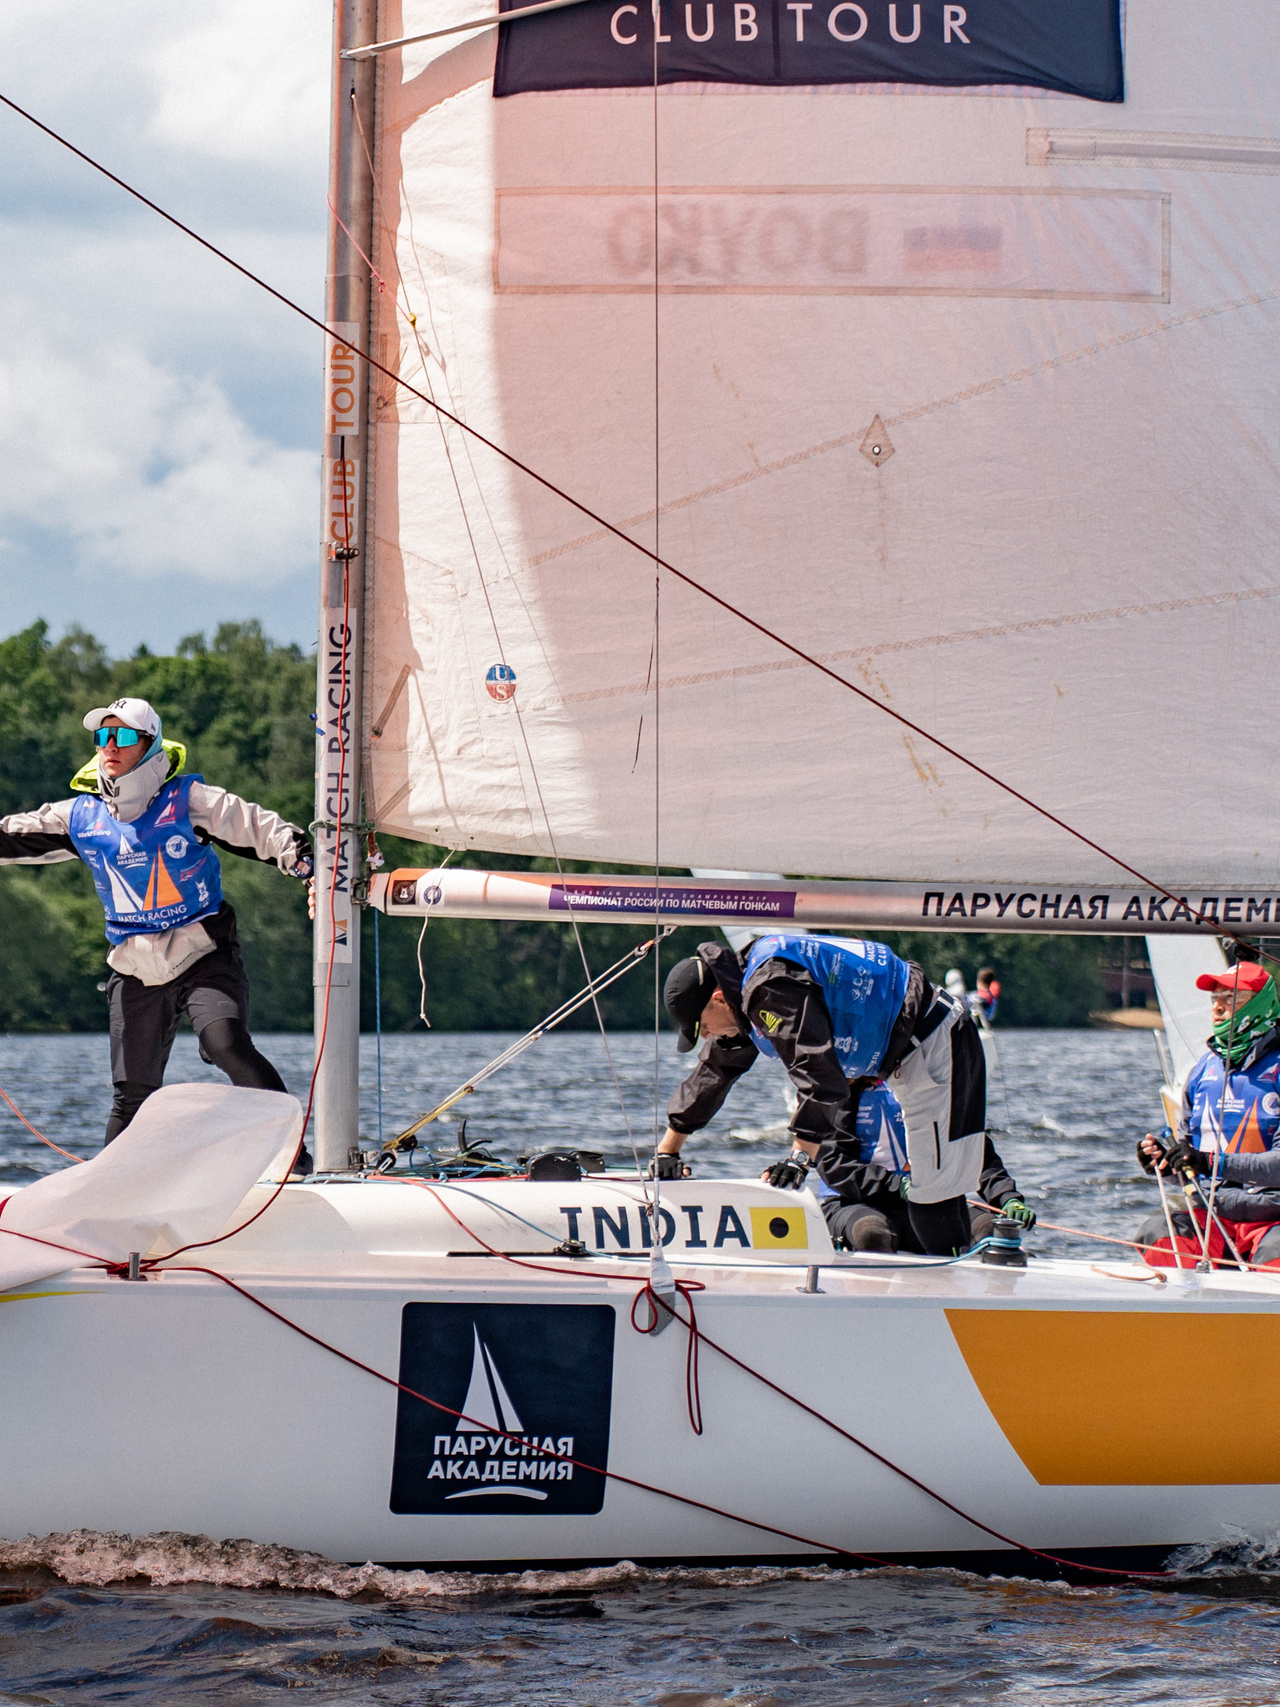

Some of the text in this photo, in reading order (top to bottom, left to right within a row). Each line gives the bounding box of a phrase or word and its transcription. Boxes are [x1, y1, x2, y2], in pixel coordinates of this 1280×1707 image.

[610, 2, 971, 45] CLUB TOUR
[330, 340, 356, 543] CLUB TOUR
[326, 622, 353, 894] MATCH RACING
[117, 912, 146, 923] MATCH
[147, 904, 187, 921] RACING
[563, 895, 780, 912] ЧЕМПИОНАТ РОССИИ ПО МАТЧЕВЫМ ГОНКАМ
[921, 890, 1280, 926] ПАРУСНАЯ АКАДЕМ
[559, 1205, 752, 1249] INDIA
[433, 1435, 574, 1458] ПАРУСНАЯ
[427, 1459, 574, 1482] АКАДЕМИЯ
